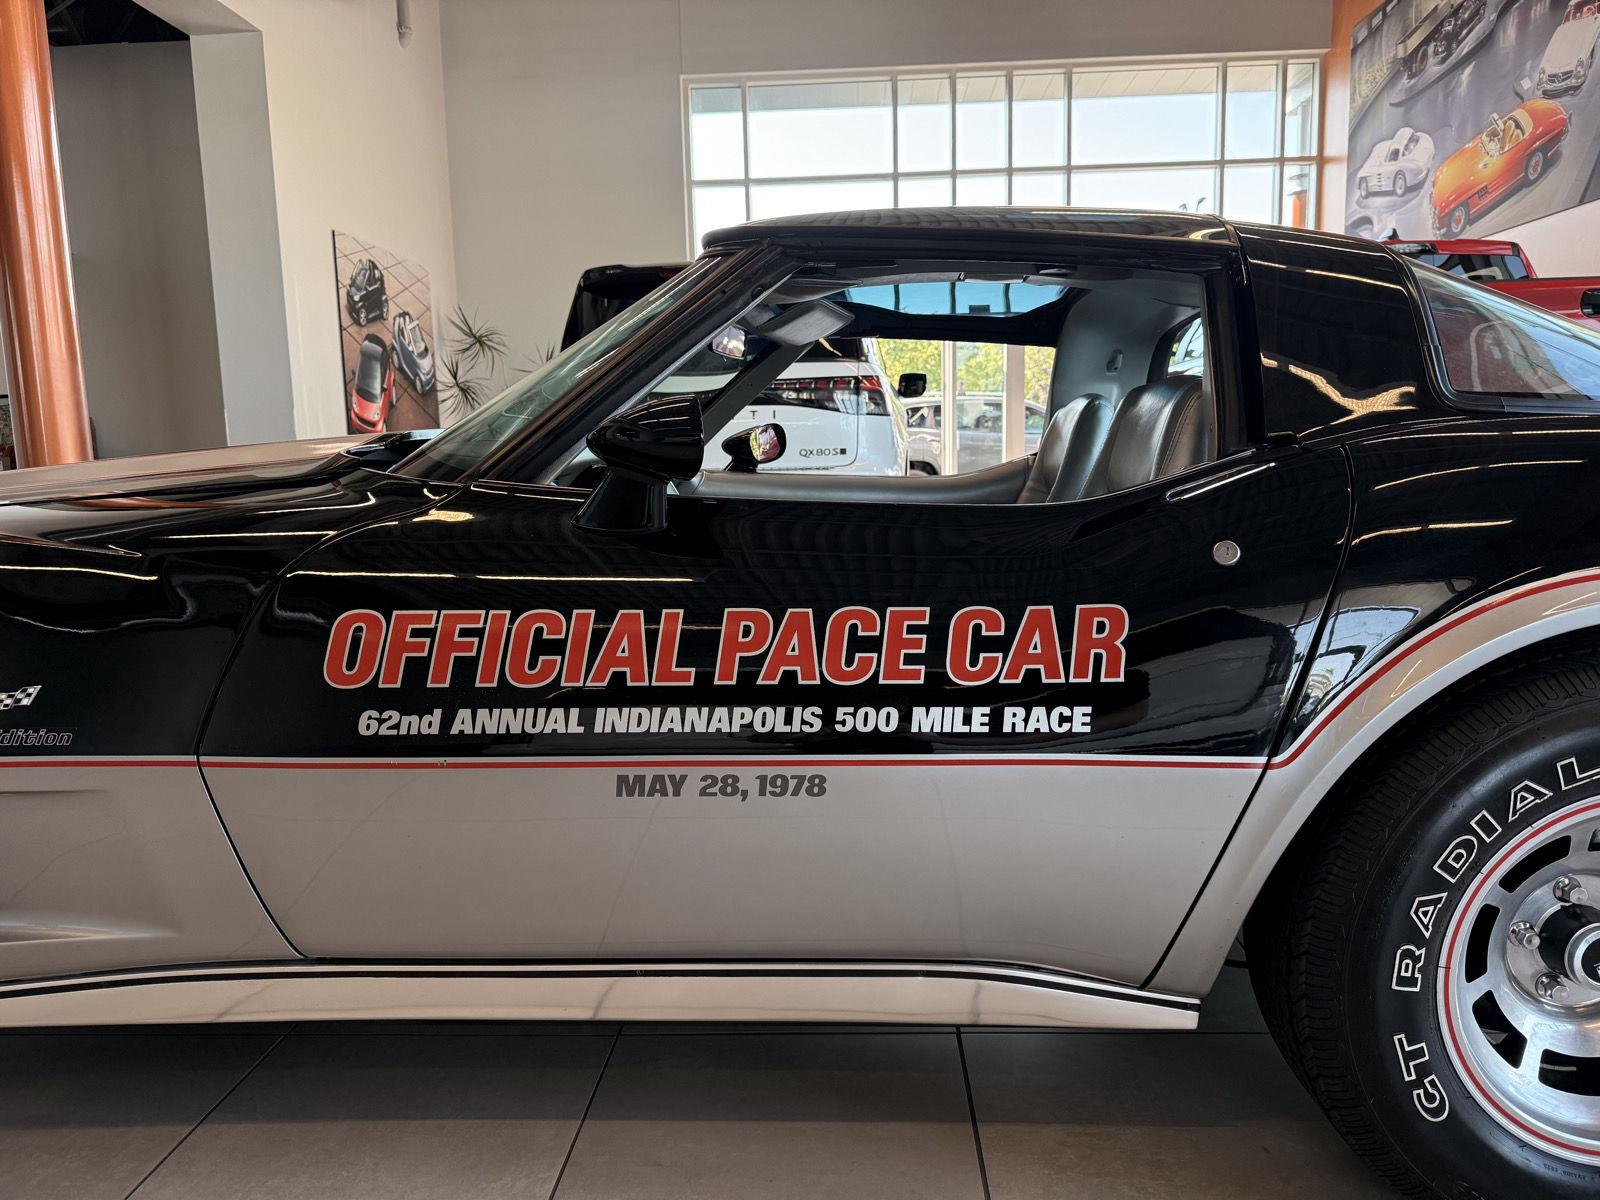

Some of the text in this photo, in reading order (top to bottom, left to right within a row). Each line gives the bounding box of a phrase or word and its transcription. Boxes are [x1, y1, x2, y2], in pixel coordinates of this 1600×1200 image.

[323, 604, 1130, 689] OFFICIAL PACE CAR
[358, 706, 1093, 736] 62nd ANNUAL INDIANAPOLIS 500 MILE RACE
[0, 728, 73, 746] dition
[615, 773, 827, 802] MAY 28, 1978
[1391, 755, 1600, 992] RADIAL
